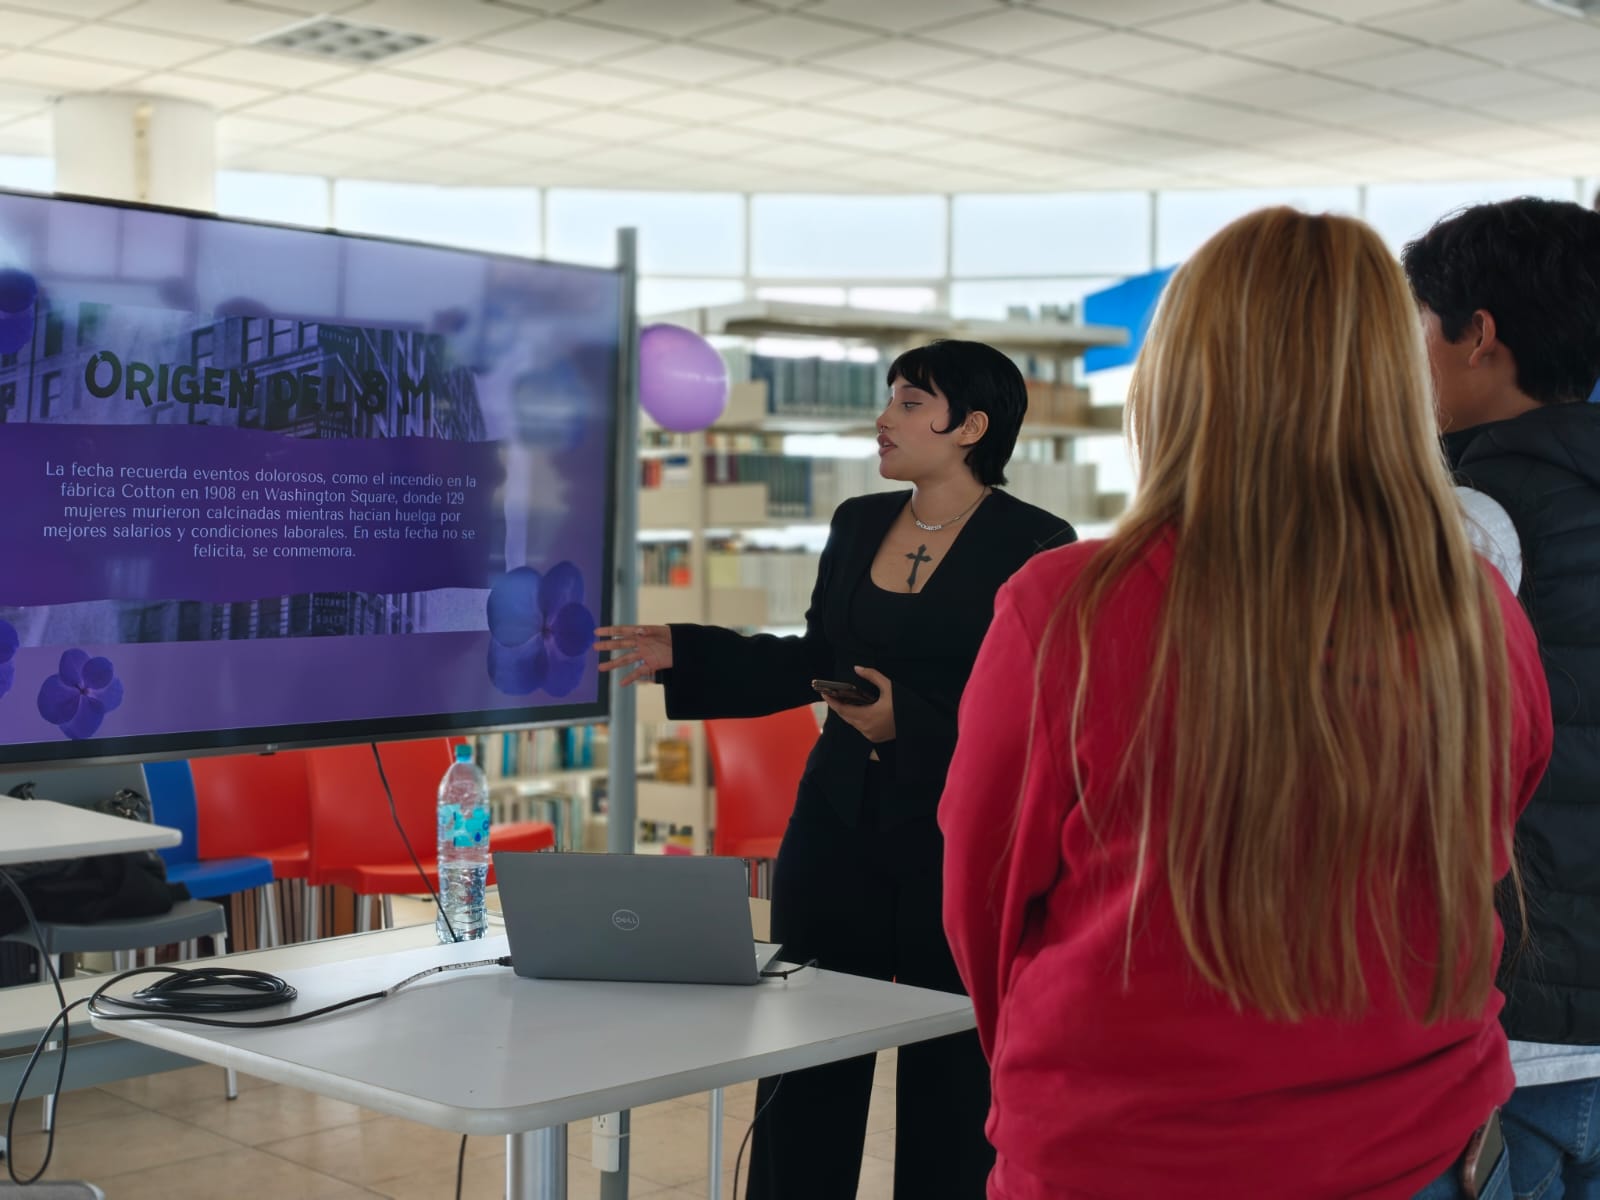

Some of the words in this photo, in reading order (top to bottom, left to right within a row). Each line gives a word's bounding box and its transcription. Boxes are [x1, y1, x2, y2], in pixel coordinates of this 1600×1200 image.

[46, 461, 64, 476] La
[72, 462, 114, 477] fecha
[120, 466, 187, 480] recuerda
[193, 468, 249, 482] eventos
[255, 468, 326, 485] dolorosos,
[332, 473, 368, 485] como
[373, 473, 384, 485] el
[390, 473, 443, 487] incendio
[447, 476, 462, 487] en
[466, 475, 476, 488] la
[61, 482, 115, 498] fábrica
[122, 484, 175, 498] Cotton
[181, 488, 198, 499] en
[205, 486, 236, 500] 1908
[242, 489, 259, 500] en
[265, 488, 345, 506] Washington
[351, 489, 398, 506] Square,
[403, 492, 442, 504] donde
[447, 492, 464, 504] 129
[64, 504, 126, 522] mujeres
[133, 504, 200, 518] murieron
[207, 506, 280, 520] calcinadas
[286, 508, 344, 521] mientras
[396, 509, 436, 524] huelga
[441, 511, 462, 525] por
[44, 523, 107, 542] mejores
[113, 524, 171, 538] salarios
[177, 527, 185, 542] y
[192, 525, 278, 539] condiciones
[284, 525, 348, 539] laborales.
[354, 526, 369, 539] En
[374, 528, 400, 539] esta
[405, 527, 438, 539] fecha
[443, 529, 457, 539] no
[462, 529, 475, 539] se
[194, 544, 246, 558] felicita,
[252, 546, 268, 557] se
[273, 546, 356, 557] conmemora.
